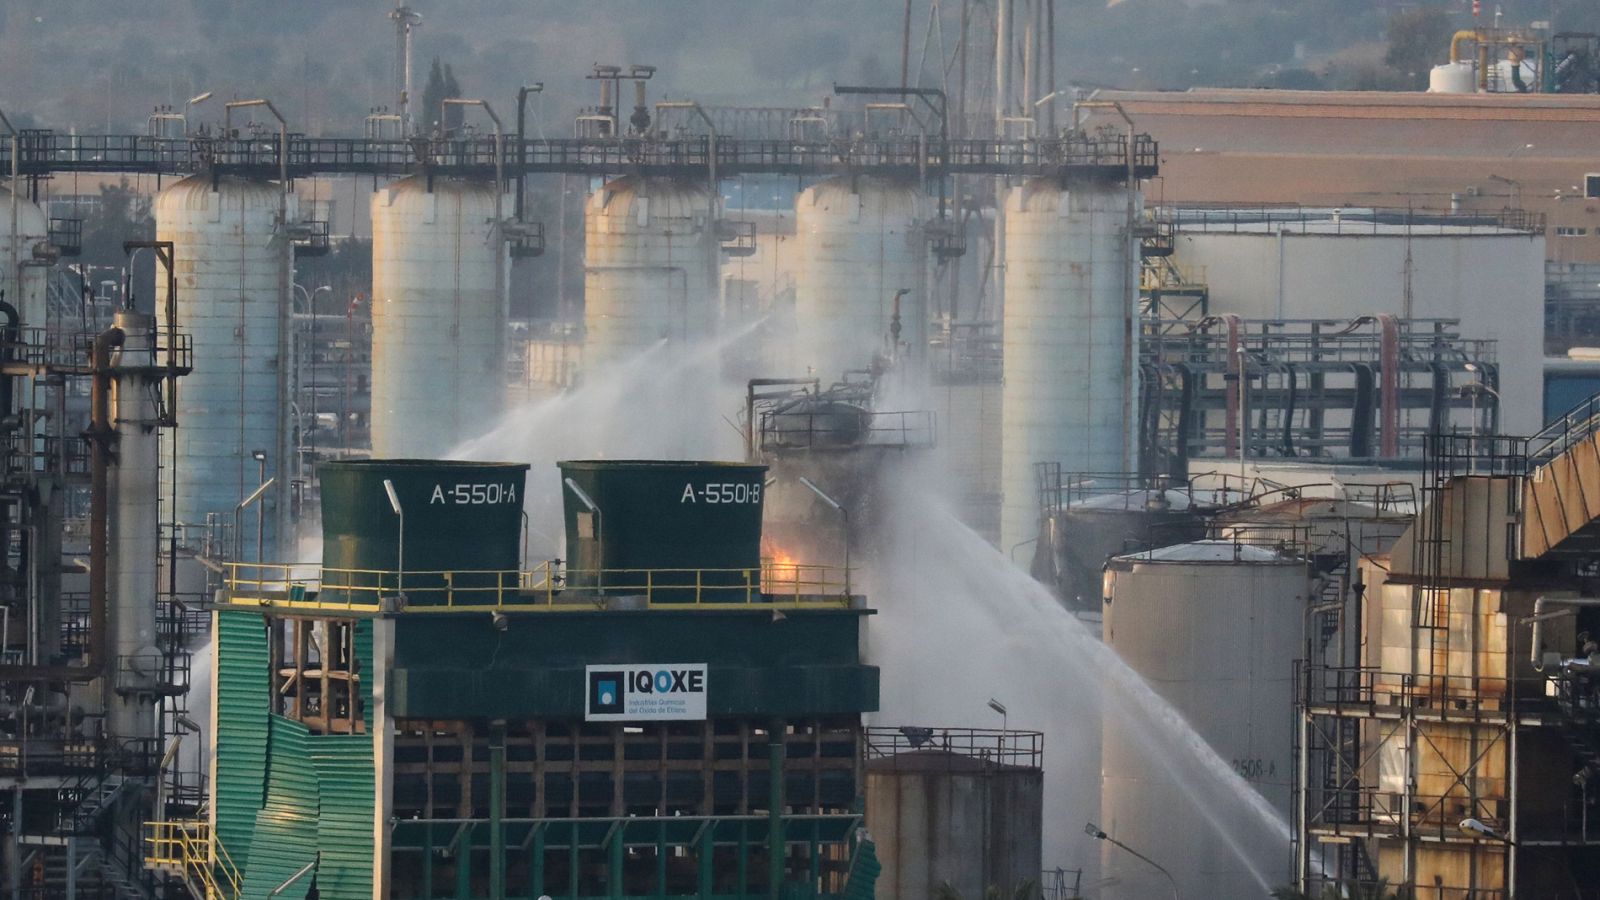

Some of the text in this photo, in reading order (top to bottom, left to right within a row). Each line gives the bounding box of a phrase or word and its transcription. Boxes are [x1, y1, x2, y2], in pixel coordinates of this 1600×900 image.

[430, 483, 516, 504] A-5501-A
[681, 483, 760, 504] A-5501-B
[628, 670, 704, 694] IQOXE
